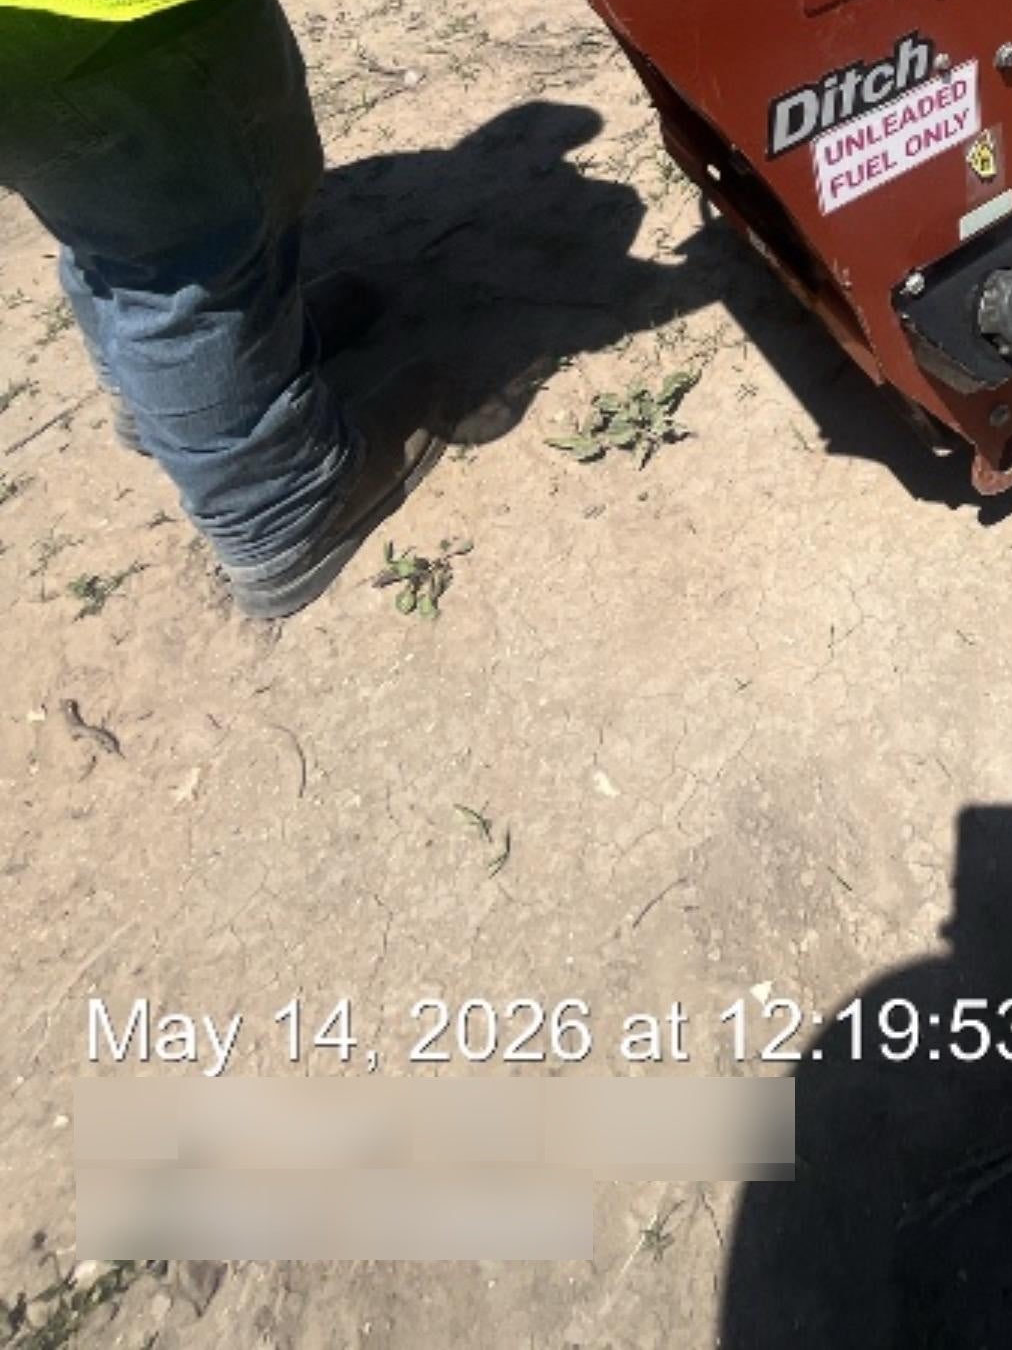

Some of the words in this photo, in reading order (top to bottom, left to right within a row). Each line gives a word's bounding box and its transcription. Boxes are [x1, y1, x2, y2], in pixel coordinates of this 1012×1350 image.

[769, 33, 931, 157] Ditch
[824, 79, 967, 166] UNLEADED
[830, 153, 897, 199] FUEL
[905, 108, 969, 158] ONLY
